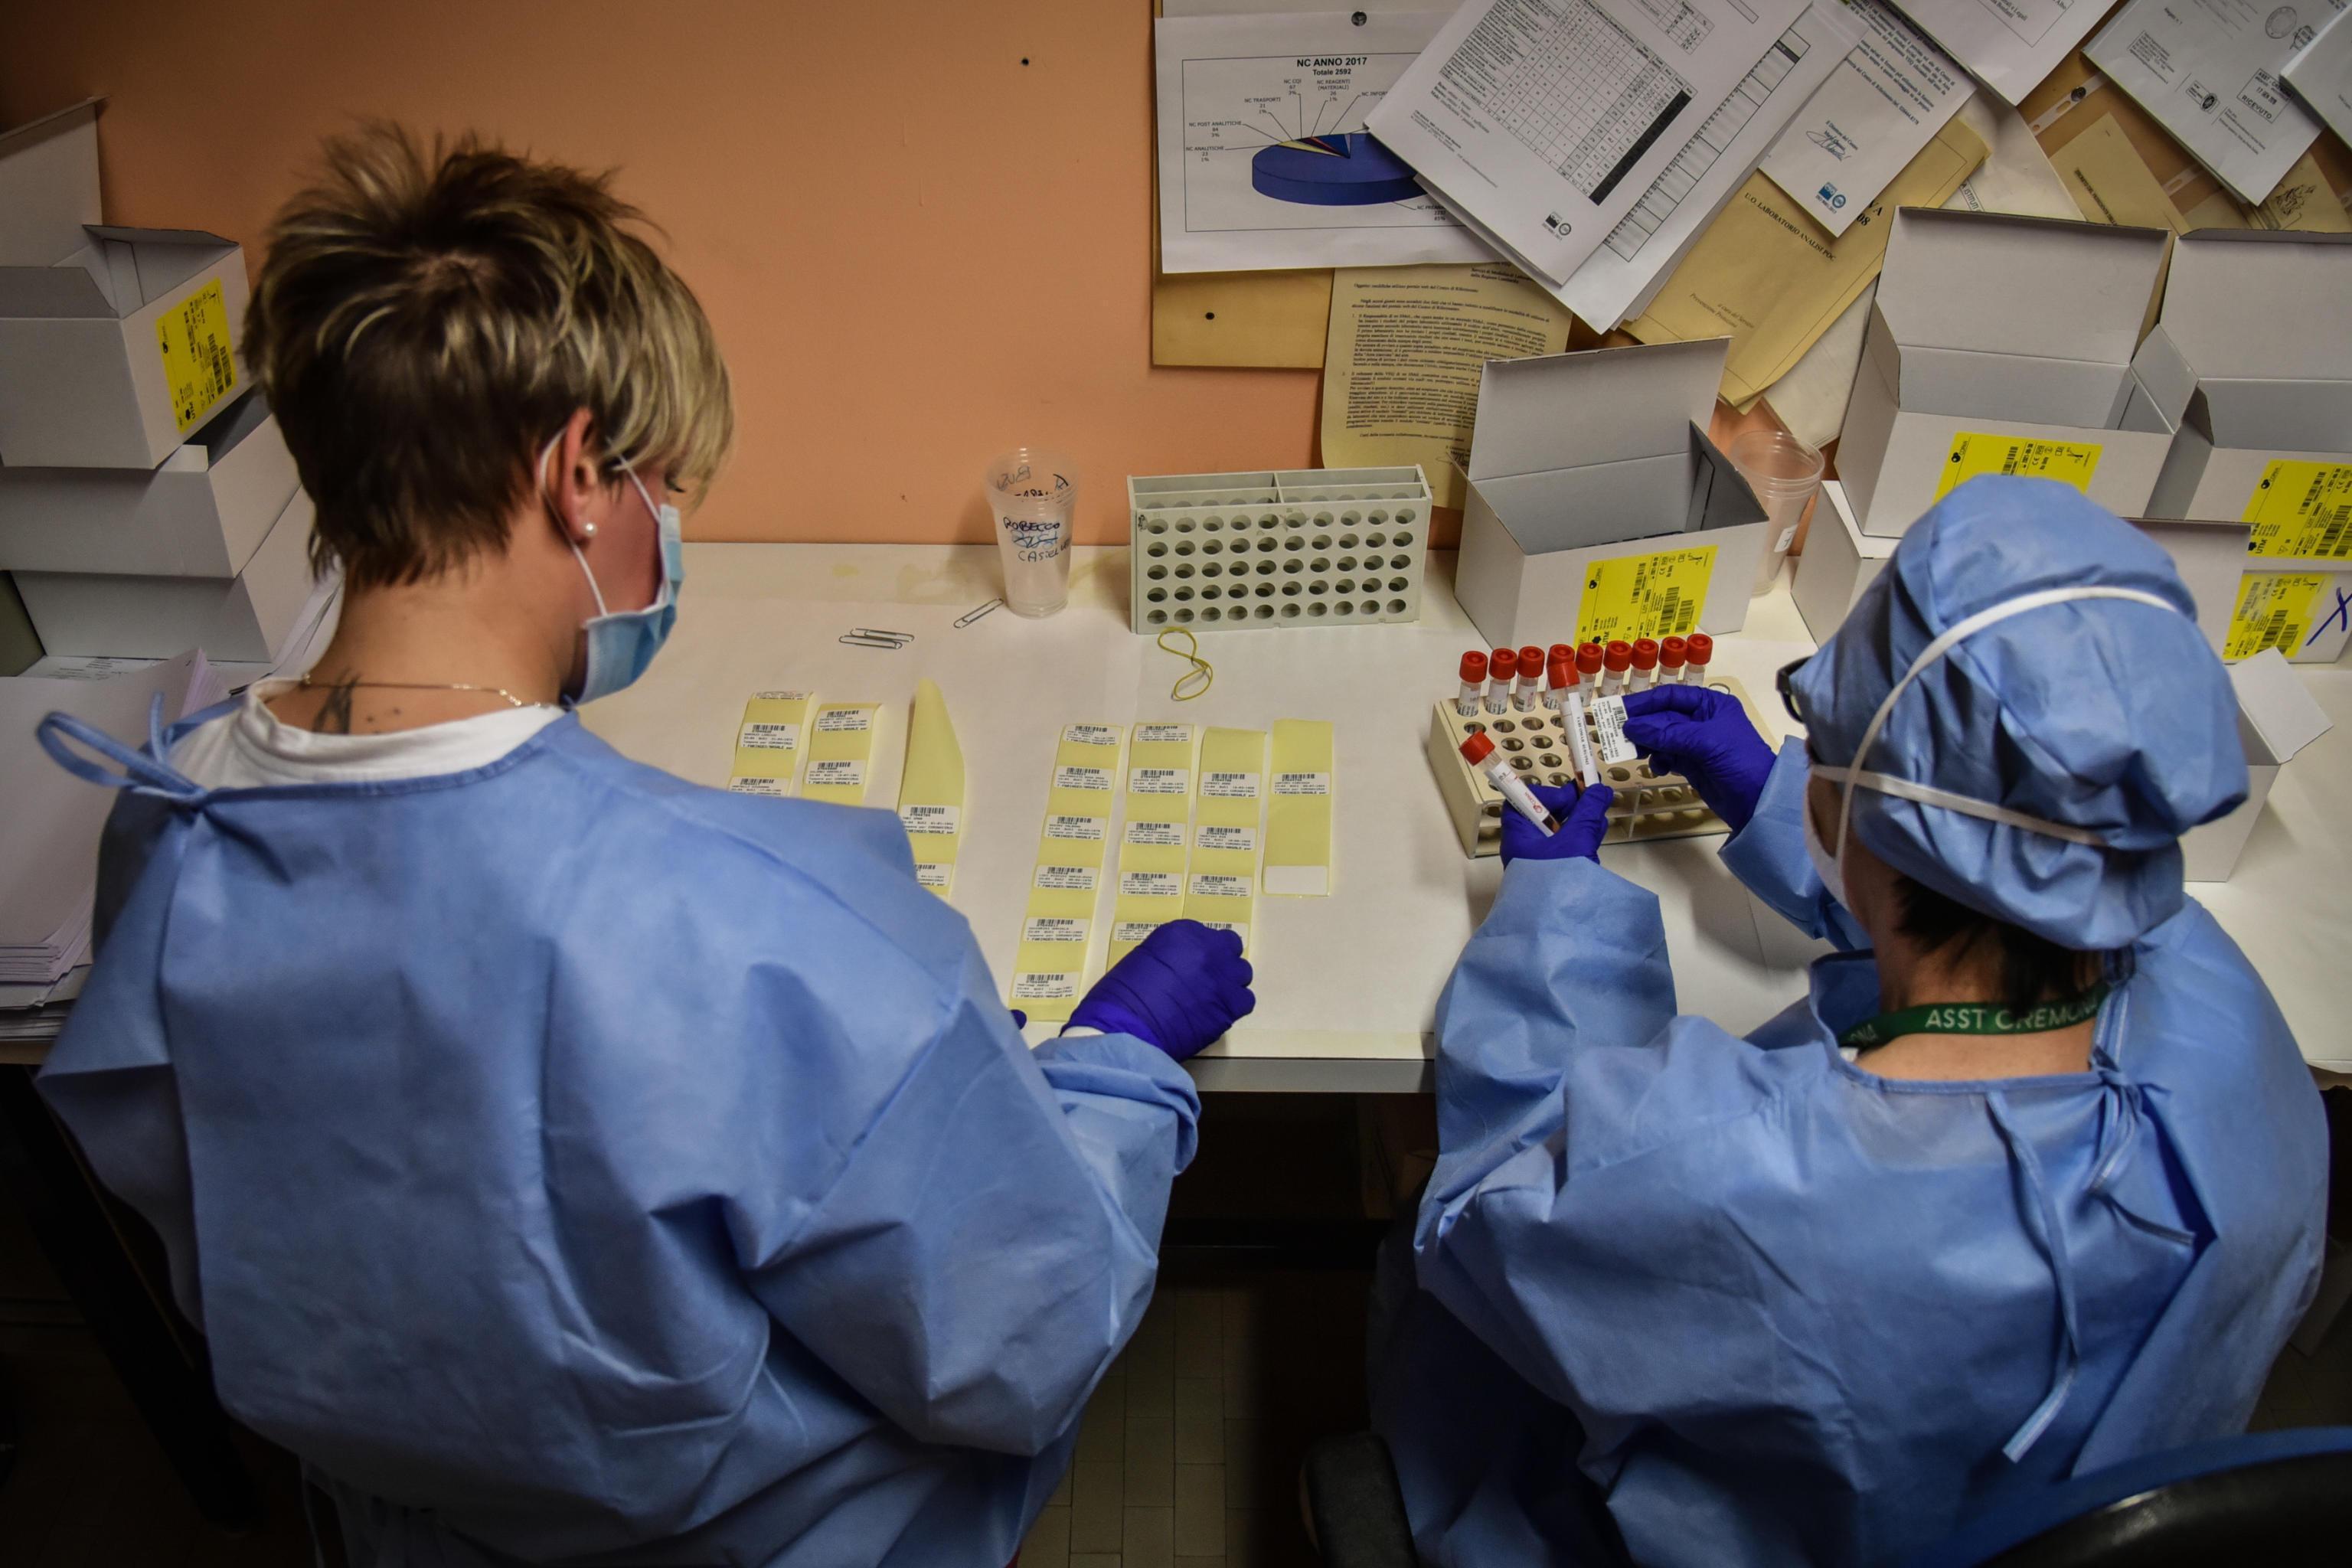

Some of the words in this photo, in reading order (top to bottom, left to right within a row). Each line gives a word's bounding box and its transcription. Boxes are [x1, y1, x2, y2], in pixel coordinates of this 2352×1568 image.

[1296, 59, 1312, 67] NC
[1345, 57, 1367, 66] 2017
[2240, 94, 2272, 119] RICEVUTO
[1744, 192, 1759, 208] U.O.
[1756, 201, 1801, 236] LABORATORIO
[1798, 232, 1824, 253] ANALISI
[1821, 249, 1836, 262] POC
[1003, 517, 1060, 532] ROBECCO
[2256, 539, 2267, 554] UTM
[1925, 1008, 1989, 1030] ASST
